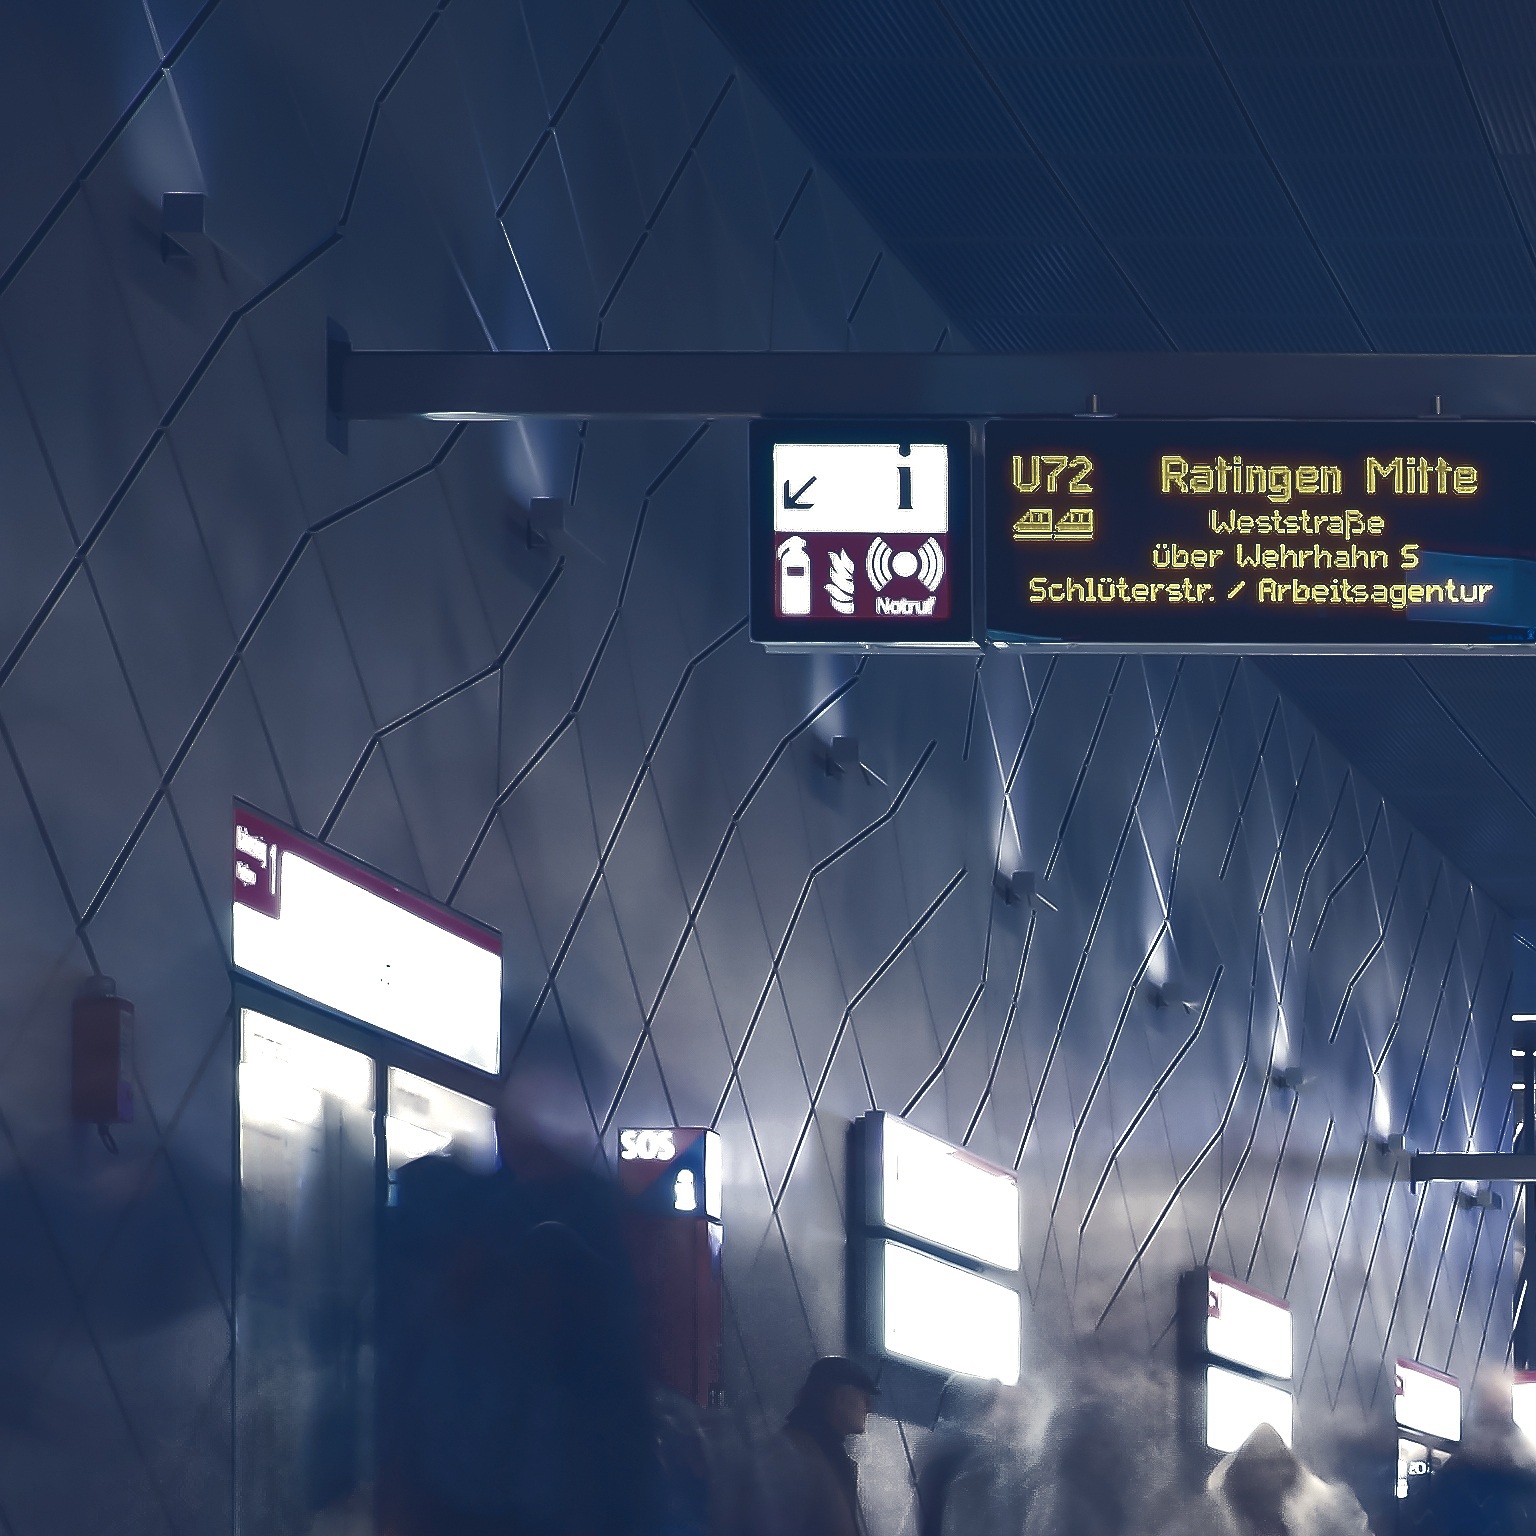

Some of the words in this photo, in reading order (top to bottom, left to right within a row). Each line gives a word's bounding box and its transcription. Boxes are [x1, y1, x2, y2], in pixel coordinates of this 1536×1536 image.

[1012, 455, 1094, 495] U72
[1161, 455, 1342, 504] Ratingen
[1366, 456, 1478, 495] Mitte
[1208, 509, 1385, 540] Weststraße
[1152, 543, 1224, 570] über
[1236, 543, 1389, 570] Wehrhahn
[1400, 543, 1420, 570] S
[875, 595, 938, 616] Notruf
[1029, 575, 1216, 604] Schlüterstr.
[1227, 580, 1246, 600] /
[1257, 576, 1494, 609] Arbeitsagentur
[621, 1129, 677, 1161] SOS
